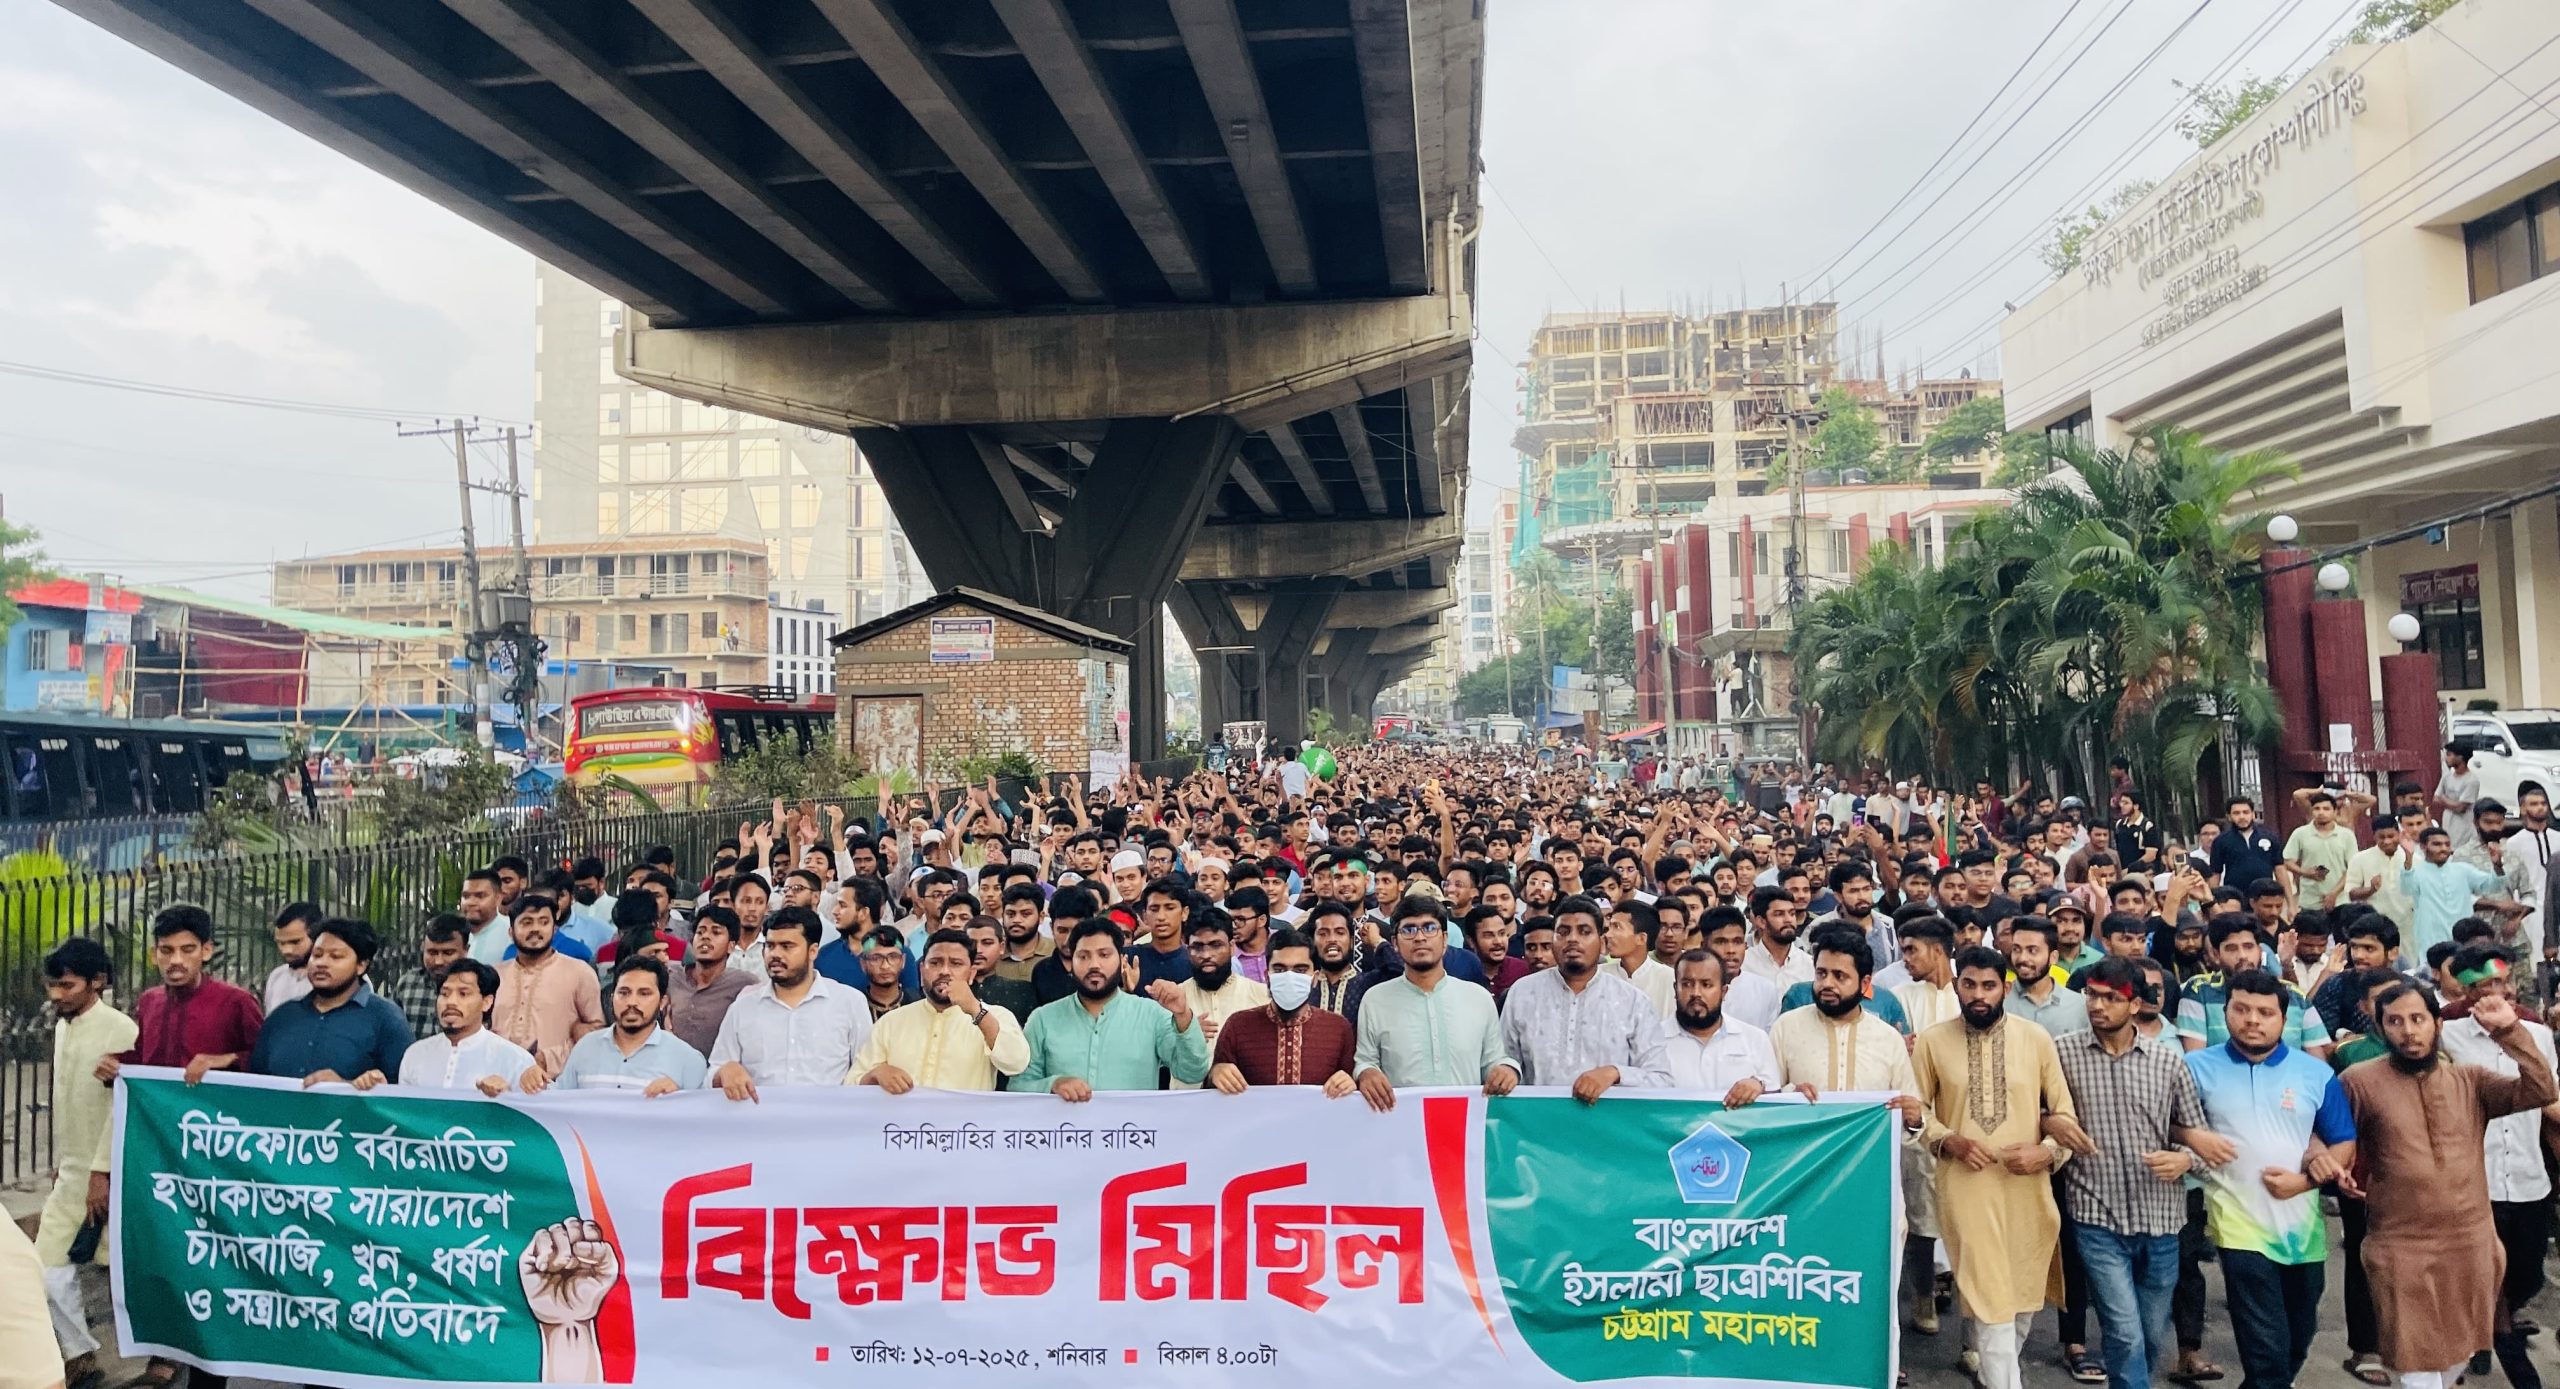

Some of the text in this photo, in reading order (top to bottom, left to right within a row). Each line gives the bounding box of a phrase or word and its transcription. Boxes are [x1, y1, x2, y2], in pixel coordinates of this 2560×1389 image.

[178, 1109, 516, 1173] মিটফোর্ডে বর্বরোচিত
[883, 1122, 1158, 1153] বিসমিল্লাহির রাহমানির রাহিম
[349, 1186, 515, 1229] সারাদেশে
[184, 1217, 509, 1291] চাঁদাবাজি, খুন, ধর্ষণ
[659, 1161, 1425, 1320] বিক্ষোভ মিছিল
[1632, 1213, 1788, 1257] বাংলাদেশ
[1562, 1252, 1863, 1307] ইসলামী ছাত্রশিবির
[185, 1288, 507, 1344] ও সন্ত্রাসের প্রতিবাদে
[1602, 1304, 1821, 1348] চট্টগ্রাম মহানগর
[850, 1339, 905, 1364] তারিখ:
[1046, 1342, 1108, 1367] শনিবার
[1157, 1341, 1211, 1367] বিকাল
[1216, 1342, 1279, 1367] ৪.০০টা
